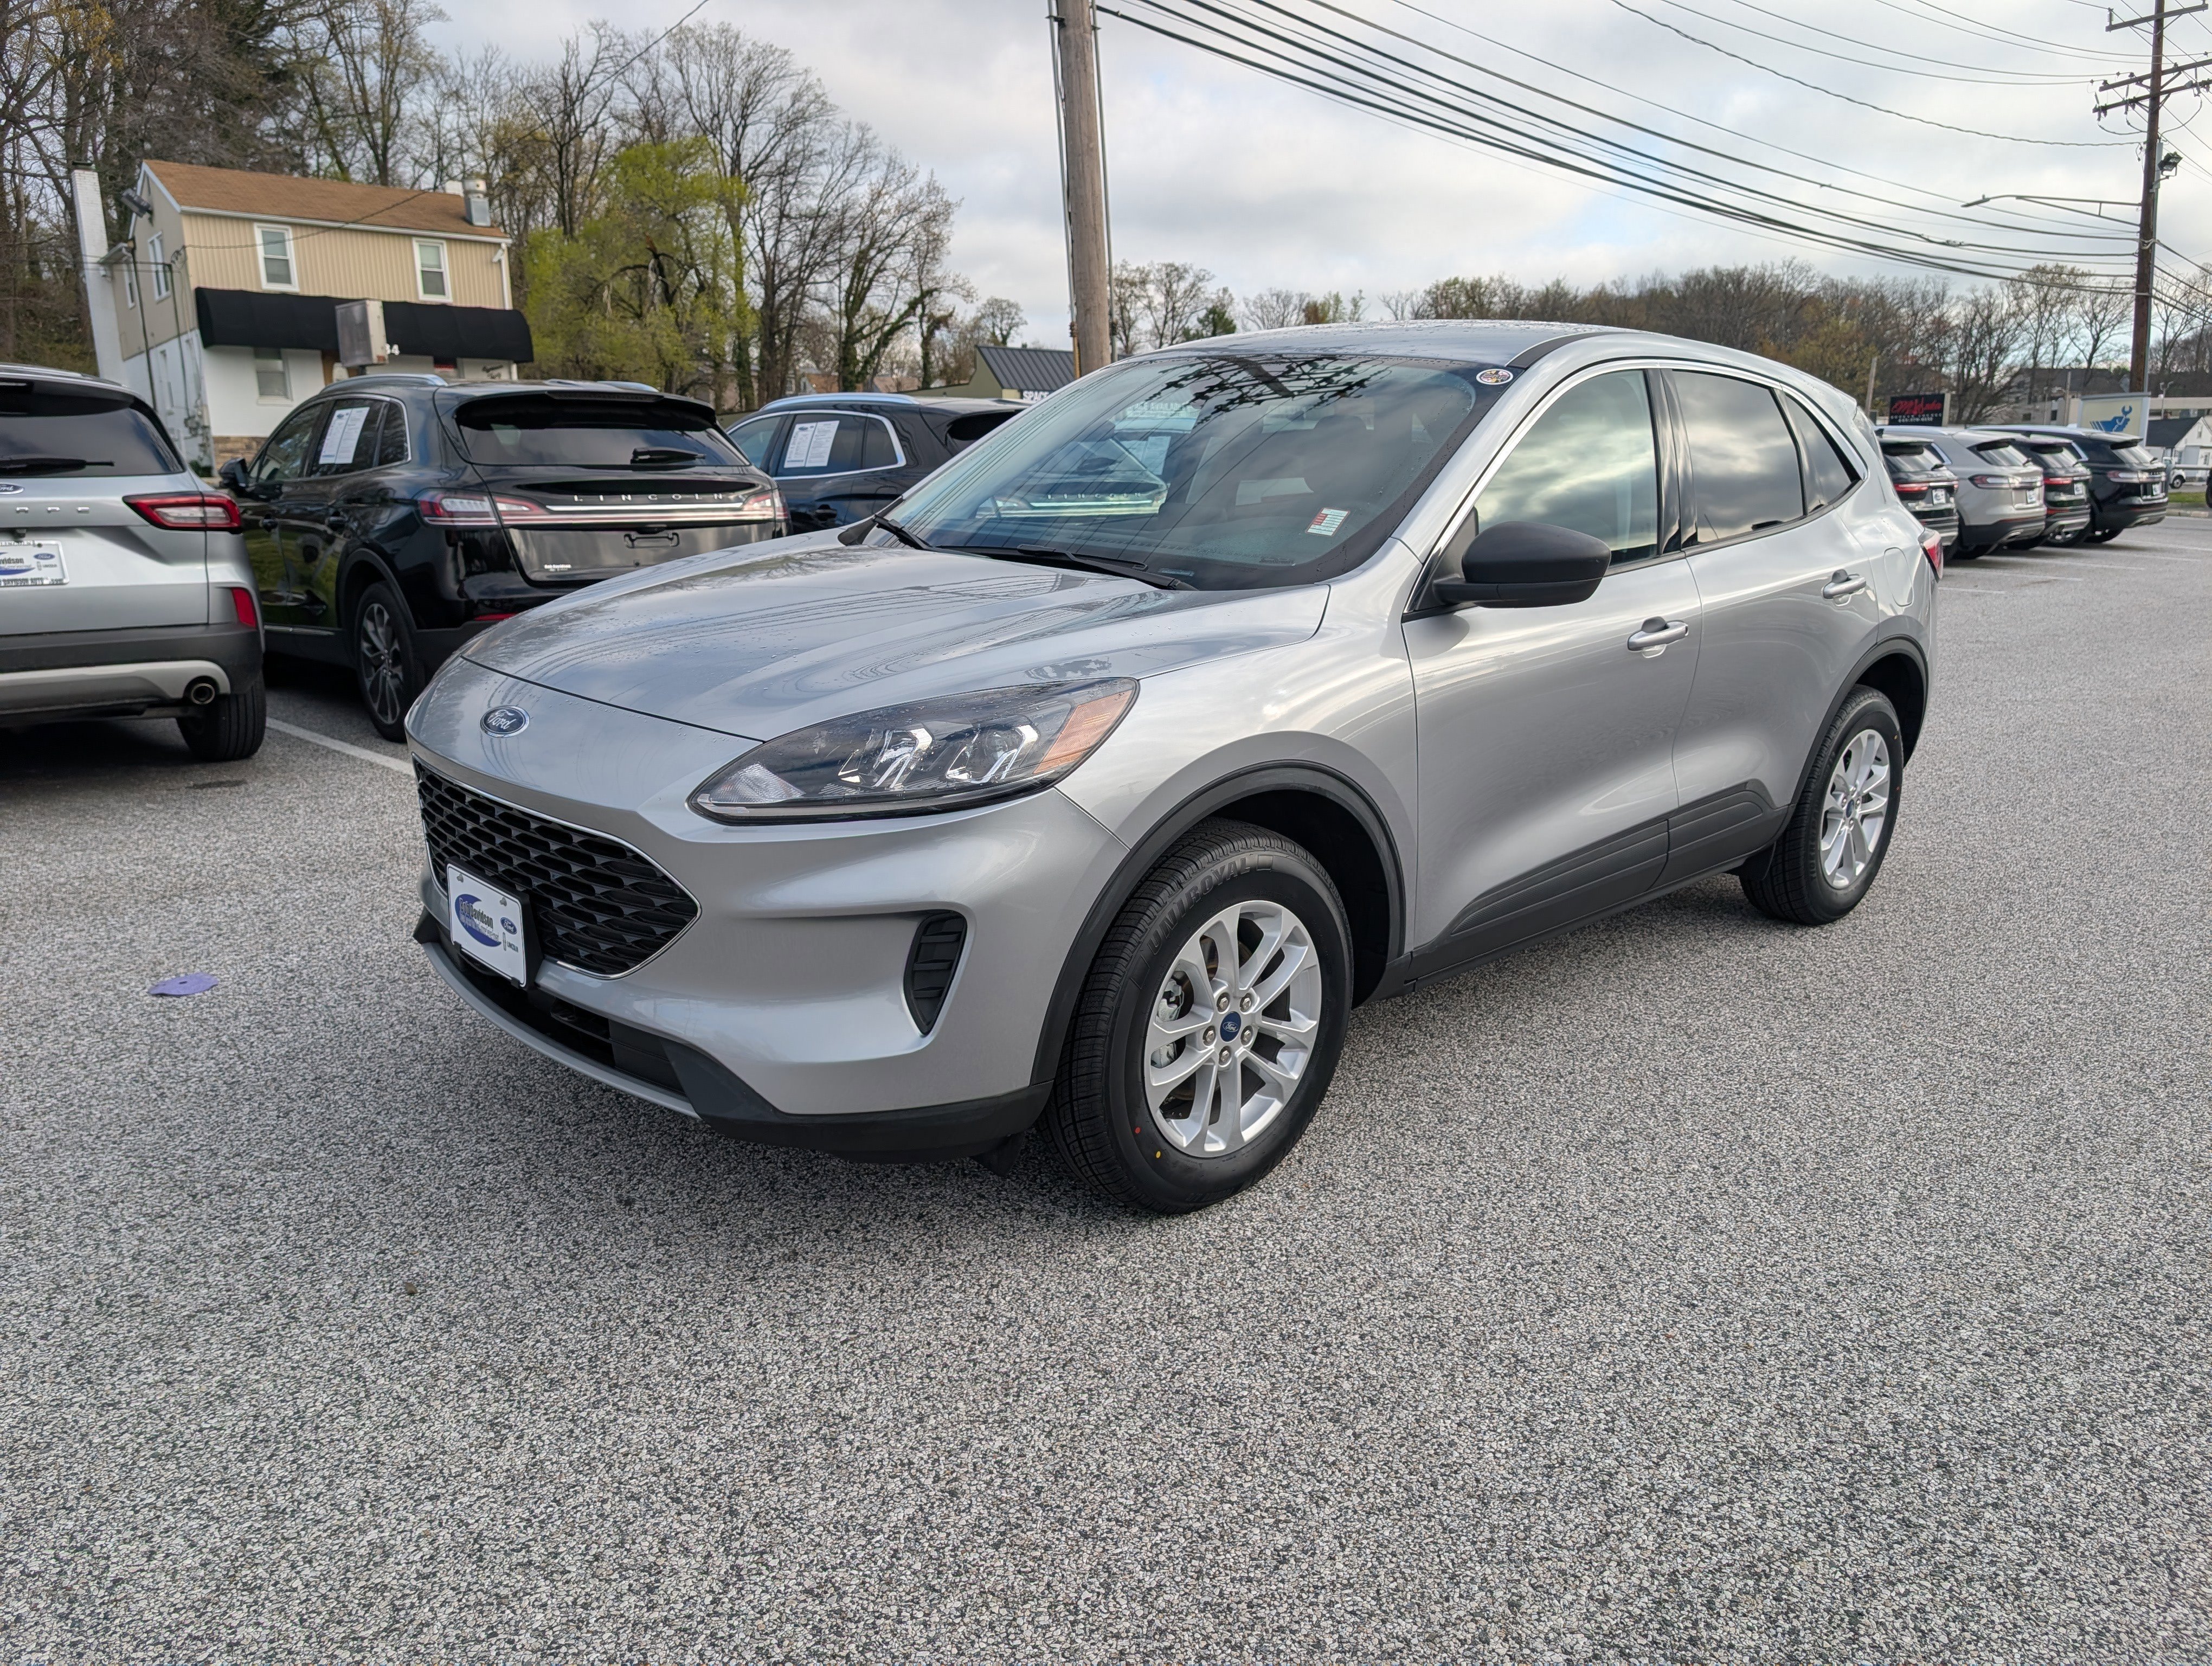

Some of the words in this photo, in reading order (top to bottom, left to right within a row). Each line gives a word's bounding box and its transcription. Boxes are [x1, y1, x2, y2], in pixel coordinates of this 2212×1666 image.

[574, 494, 723, 502] LINCOLN
[470, 902, 494, 930] Davidson
[1147, 857, 1251, 956] UNIROYAL
